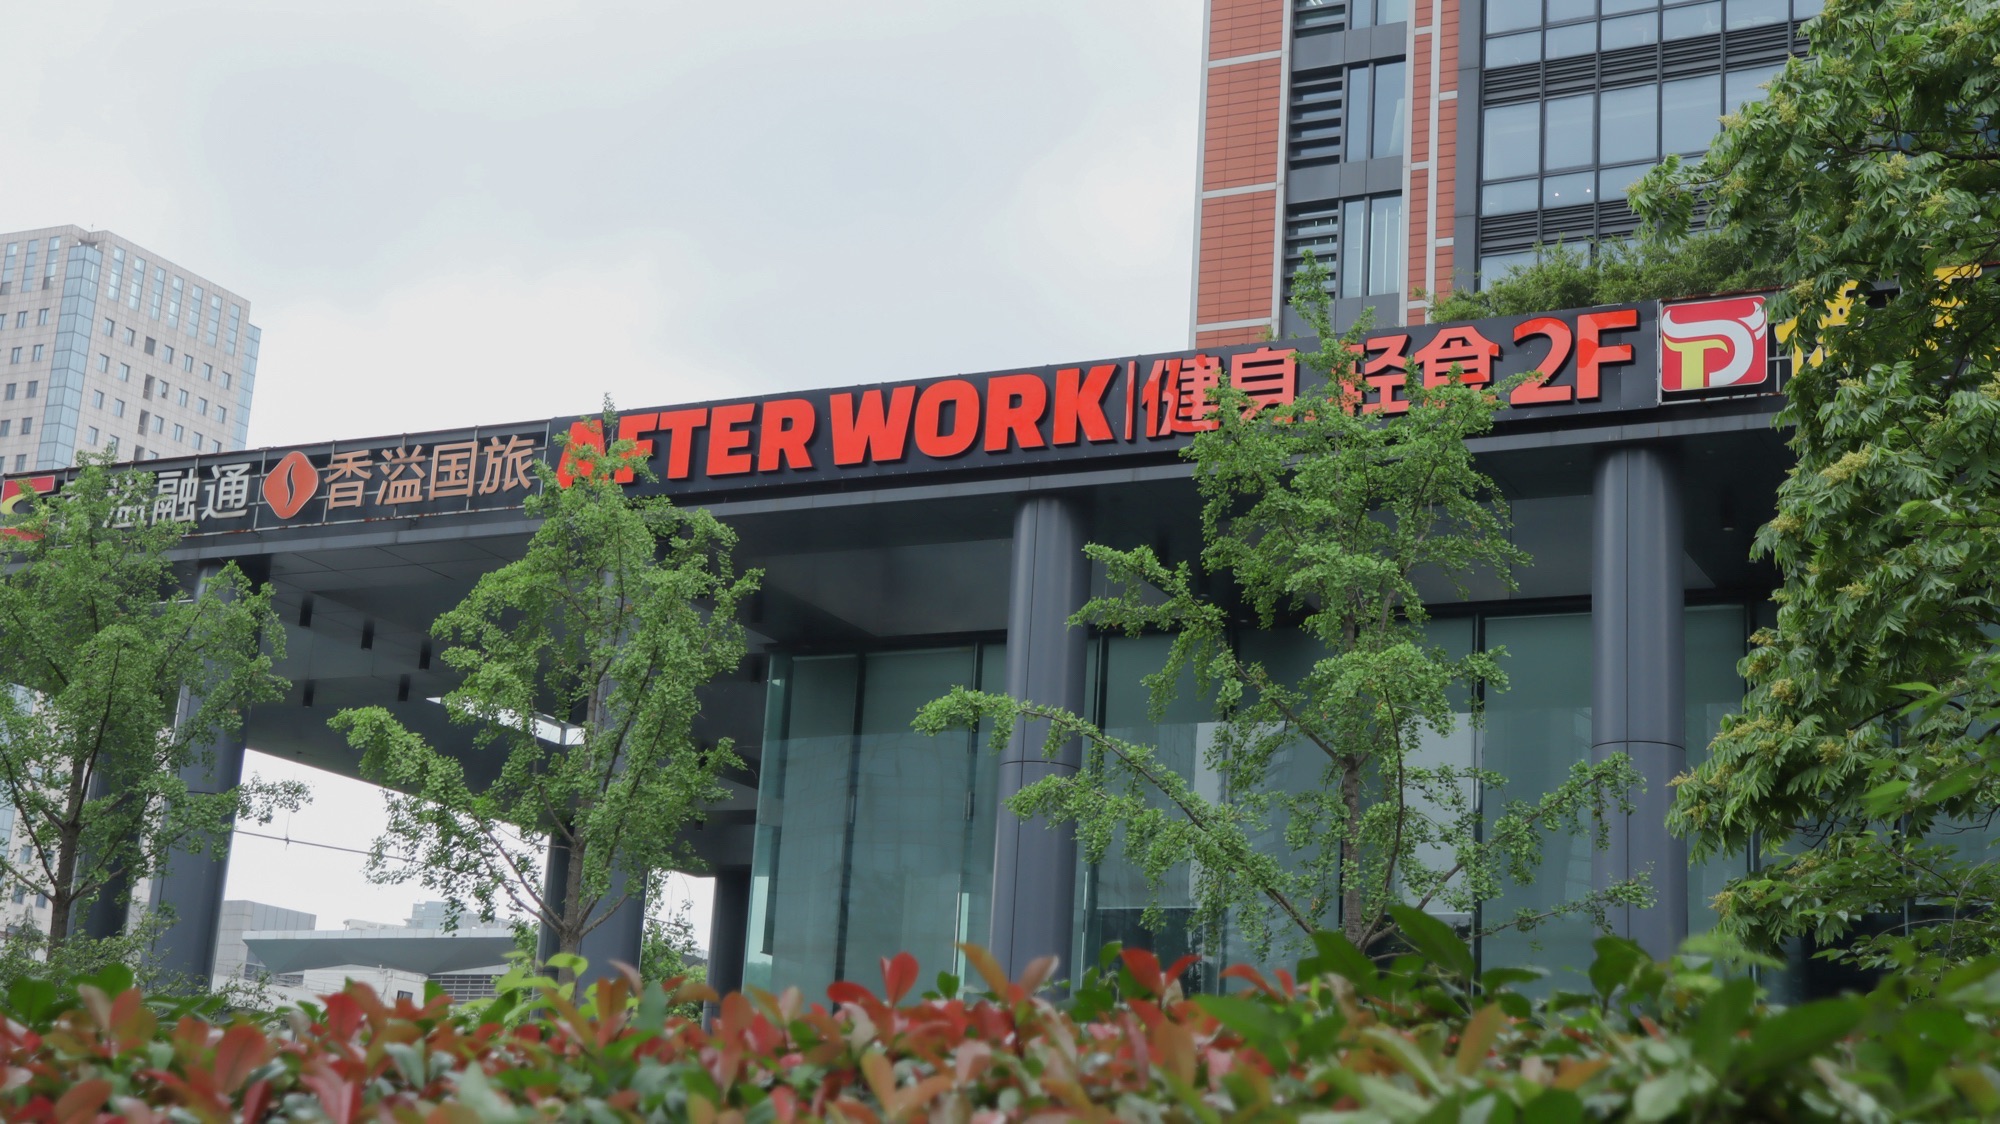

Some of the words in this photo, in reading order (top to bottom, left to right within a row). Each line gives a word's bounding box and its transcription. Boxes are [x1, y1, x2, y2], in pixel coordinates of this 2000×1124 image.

[557, 399, 816, 489] AFTER
[830, 365, 1118, 466] WORK
[1511, 309, 1638, 405] 2F
[62, 463, 252, 527] 溢融通
[325, 435, 534, 509] 香溢国旅
